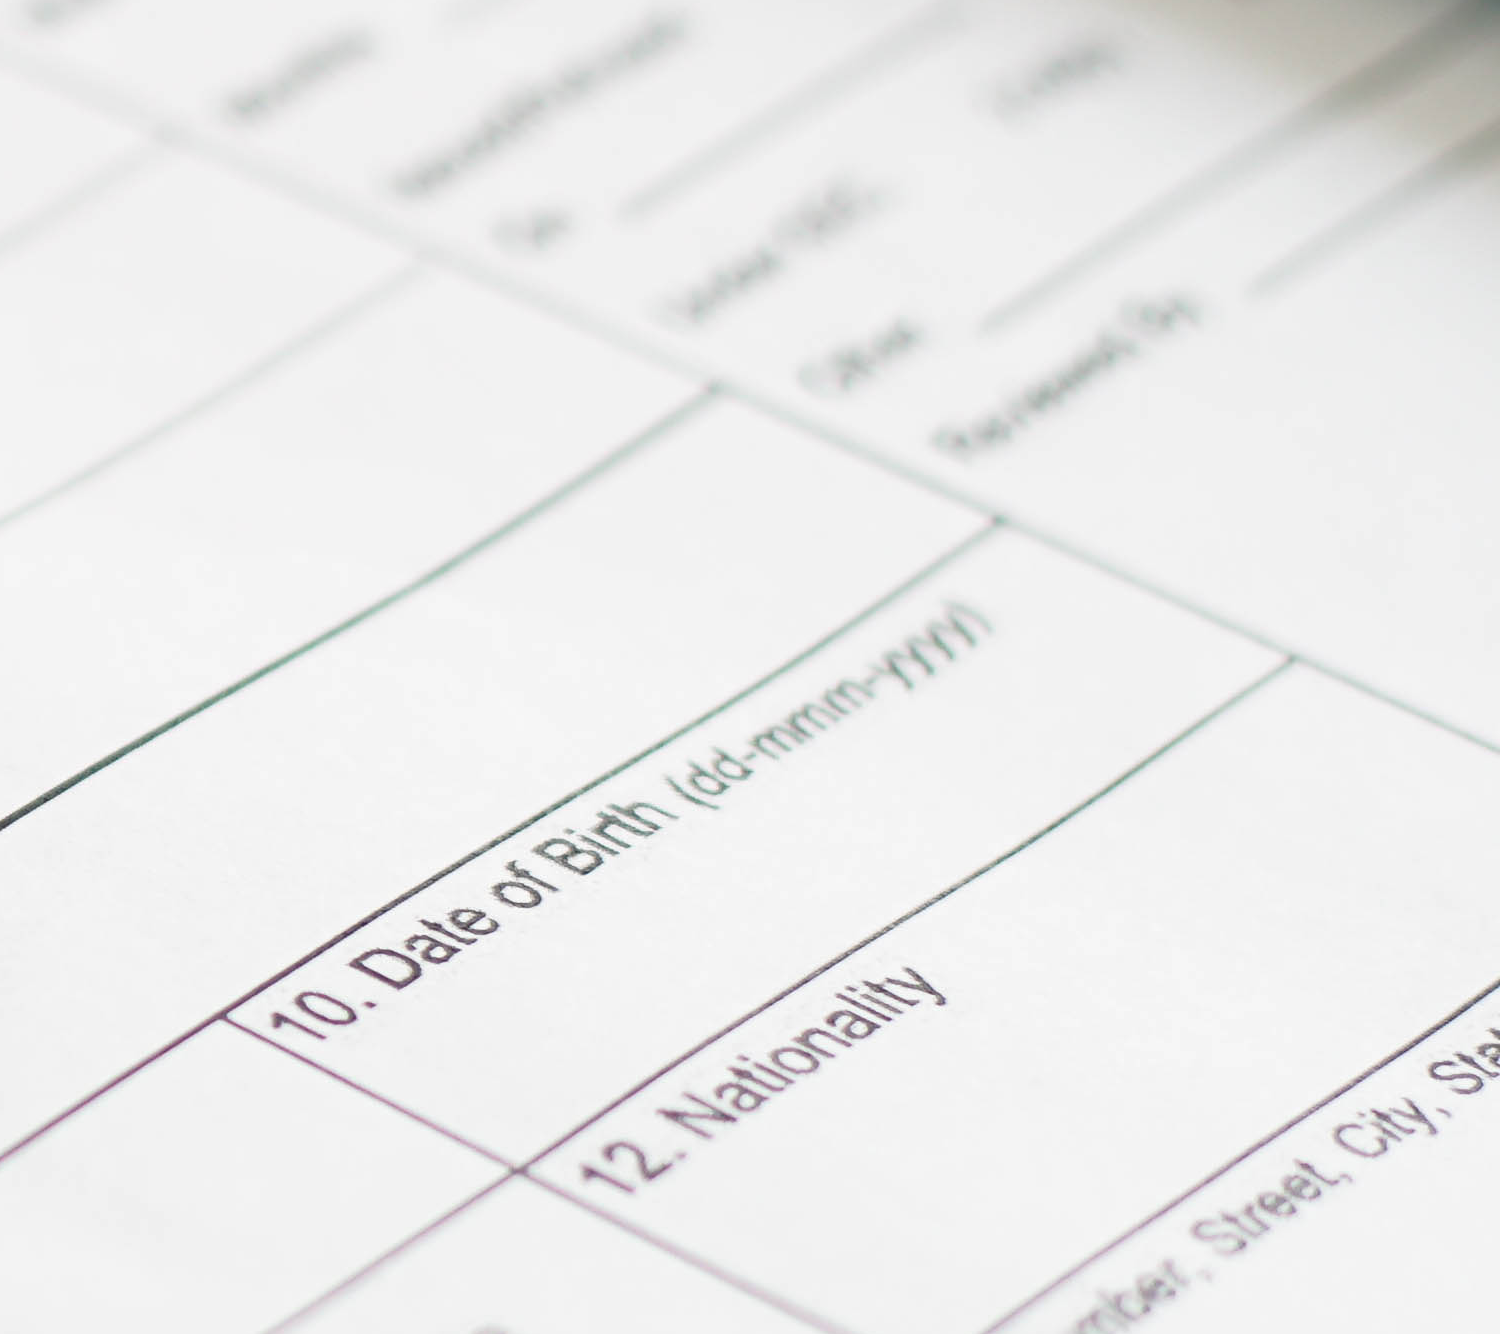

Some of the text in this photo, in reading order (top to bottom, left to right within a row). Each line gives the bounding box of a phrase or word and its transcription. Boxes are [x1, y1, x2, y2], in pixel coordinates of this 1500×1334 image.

[270, 600, 997, 1041] 10. Date of Birth (dd-mmm-yyyy)
[580, 966, 948, 1196] 12. Nationality
[1190, 1158, 1353, 1257] Street,
[1331, 1097, 1452, 1158] City,
[1428, 1027, 1500, 1095] Sta
